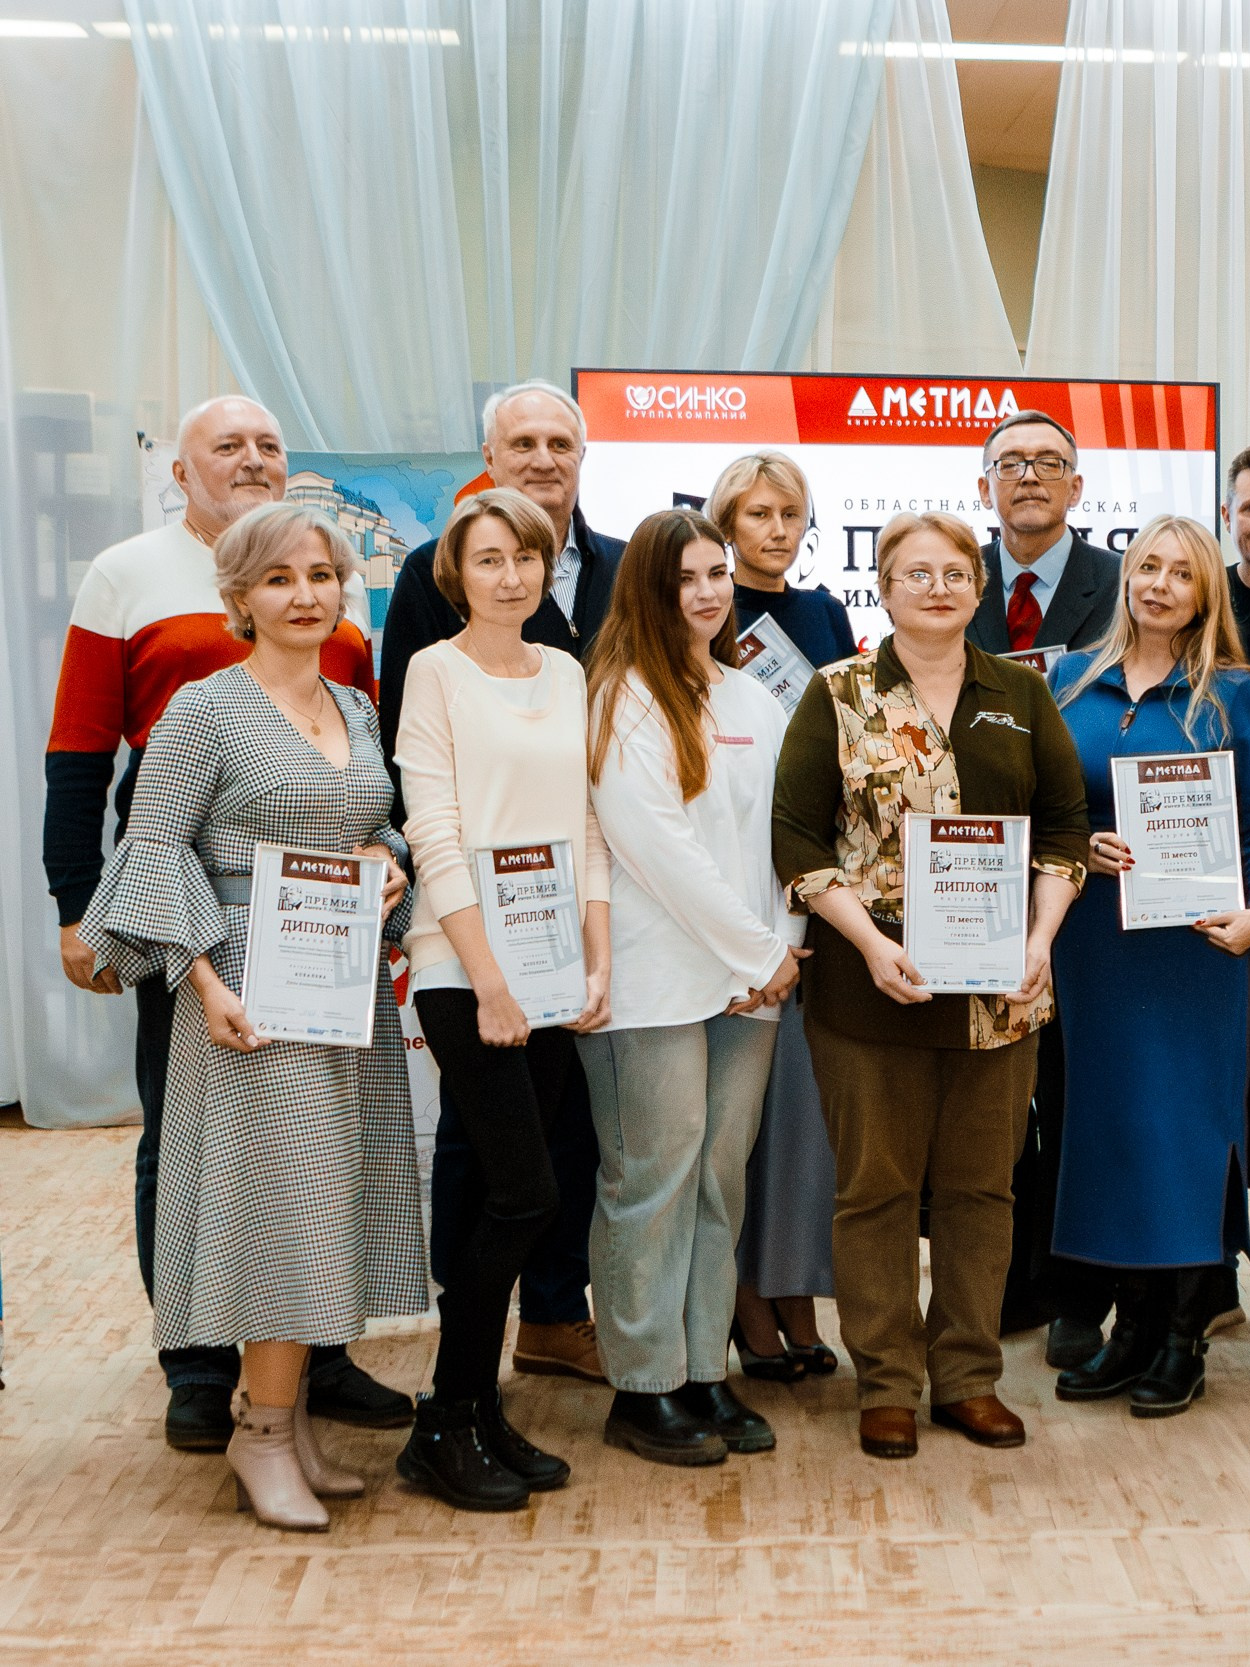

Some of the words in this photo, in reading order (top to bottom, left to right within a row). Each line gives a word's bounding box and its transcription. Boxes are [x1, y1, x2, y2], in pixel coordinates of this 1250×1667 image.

[658, 386, 747, 411] СИНКО
[882, 386, 1020, 419] МЕТИДА
[626, 410, 673, 419] ГРУППА
[677, 410, 747, 420] КОМПАНИЙ
[847, 419, 951, 428] КНИГОТОРГОВАЯ
[957, 421, 997, 429] КОМПА
[844, 499, 981, 512] ОБЛАСТНАЯ
[1156, 764, 1200, 776] МЕТИДА
[1163, 793, 1212, 803] ПРЕМИЯ
[1146, 816, 1209, 832] ДИПЛОМ
[949, 826, 994, 837] МЕТИДА
[508, 852, 546, 865] МЕТИДА
[954, 857, 1003, 867] ПРЕМИЯ
[301, 861, 351, 877] МЕТИДА
[517, 884, 557, 896] ПРЕМИЯ
[934, 881, 998, 894] ДИПЛОМ
[305, 895, 357, 909] ПРЕМИЯ
[504, 909, 556, 927] ДИПЛОМ
[281, 919, 350, 937] ДИПЛОМ
